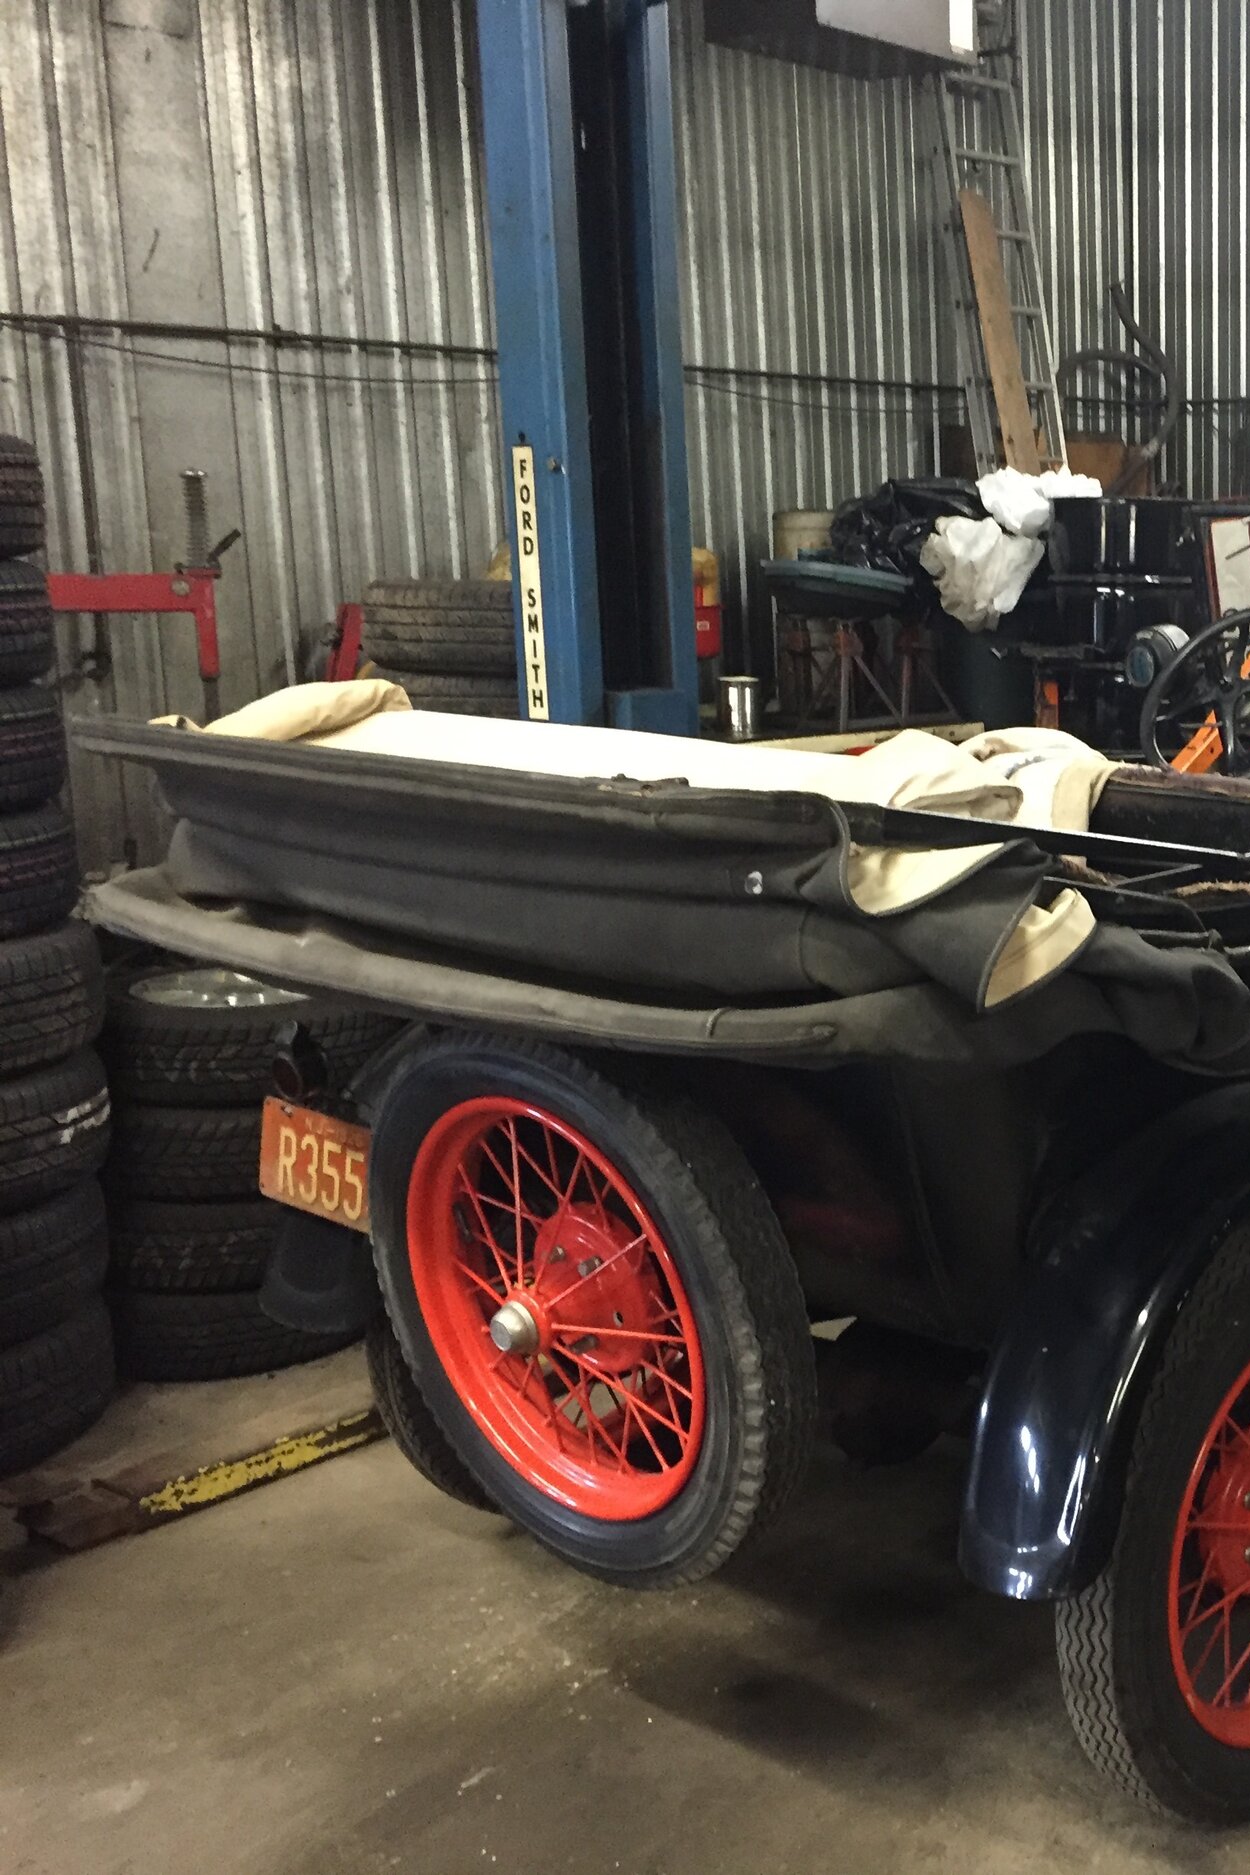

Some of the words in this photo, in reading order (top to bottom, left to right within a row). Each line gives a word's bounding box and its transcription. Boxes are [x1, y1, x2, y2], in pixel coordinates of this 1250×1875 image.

[519, 459, 534, 556] FORD
[526, 588, 544, 709] SMITH
[277, 1126, 365, 1221] R355
